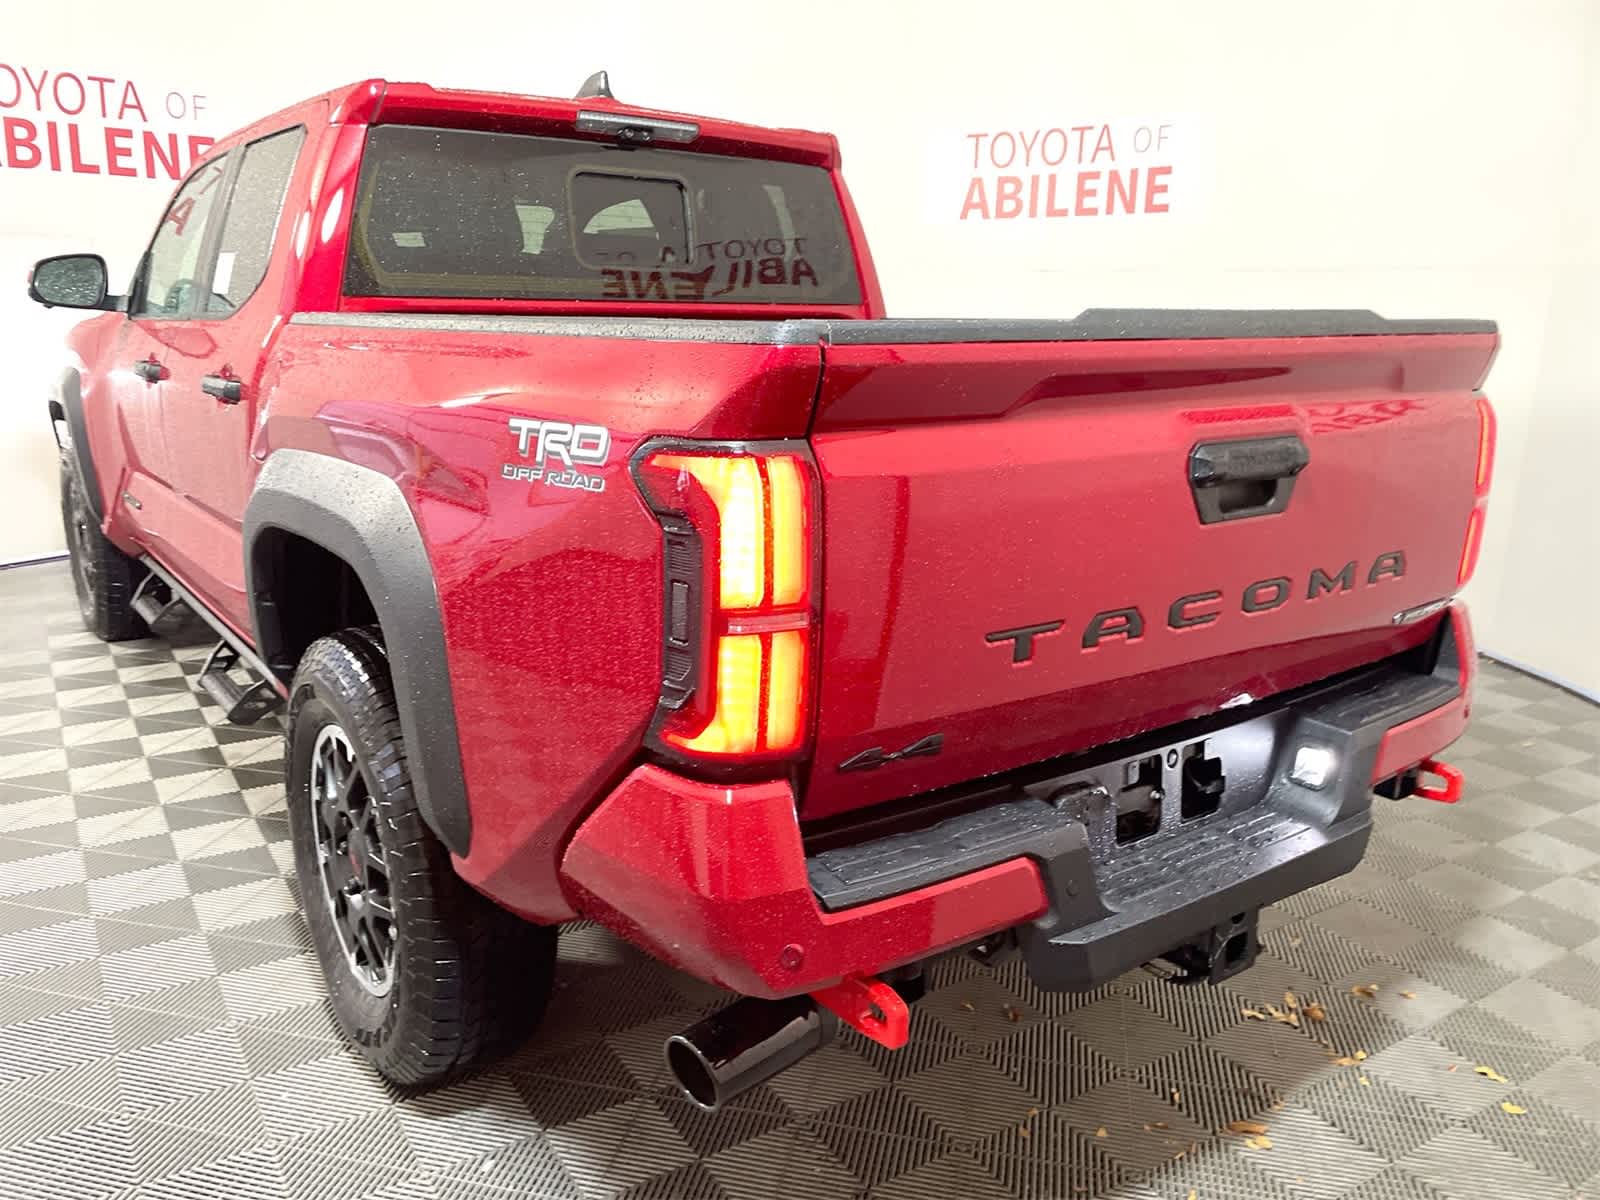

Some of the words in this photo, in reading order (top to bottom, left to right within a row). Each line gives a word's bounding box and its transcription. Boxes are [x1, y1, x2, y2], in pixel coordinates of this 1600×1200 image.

[166, 91, 207, 120] OF
[0, 116, 214, 181] BILEN
[967, 124, 1116, 168] TOYOTA
[1133, 124, 1172, 153] OF
[959, 166, 1173, 220] ABILENE
[508, 416, 611, 471] TRD
[501, 463, 544, 483] OFF
[544, 470, 606, 493] ROAD
[984, 549, 1407, 666] TACOMA
